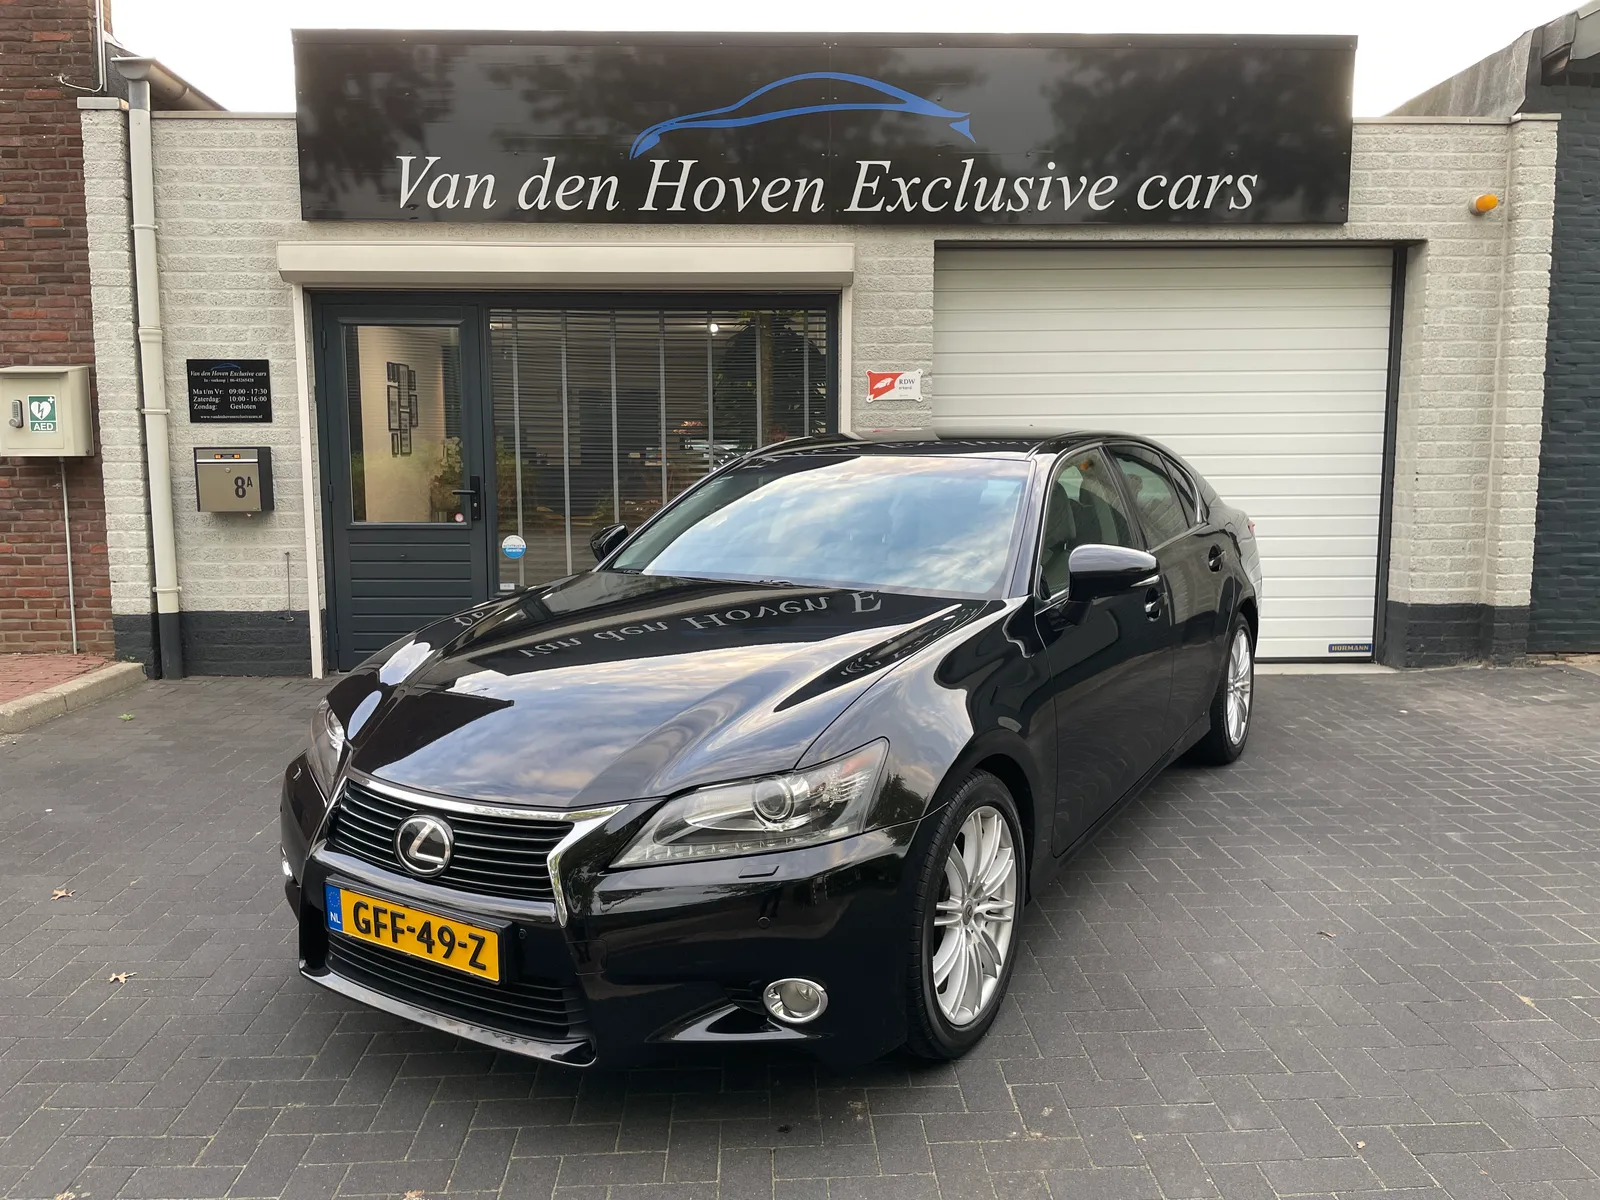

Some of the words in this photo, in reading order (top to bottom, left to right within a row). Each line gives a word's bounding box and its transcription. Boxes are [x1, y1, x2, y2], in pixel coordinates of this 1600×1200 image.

[396, 155, 497, 210] Van
[517, 156, 620, 211] den
[638, 159, 825, 213] Hoven
[843, 158, 1119, 212] Exclusive
[1137, 173, 1258, 210] cars
[193, 403, 218, 411] Zondag:
[33, 422, 54, 431] AED
[330, 911, 341, 925] NL
[353, 900, 487, 971] GFF-49-Z
